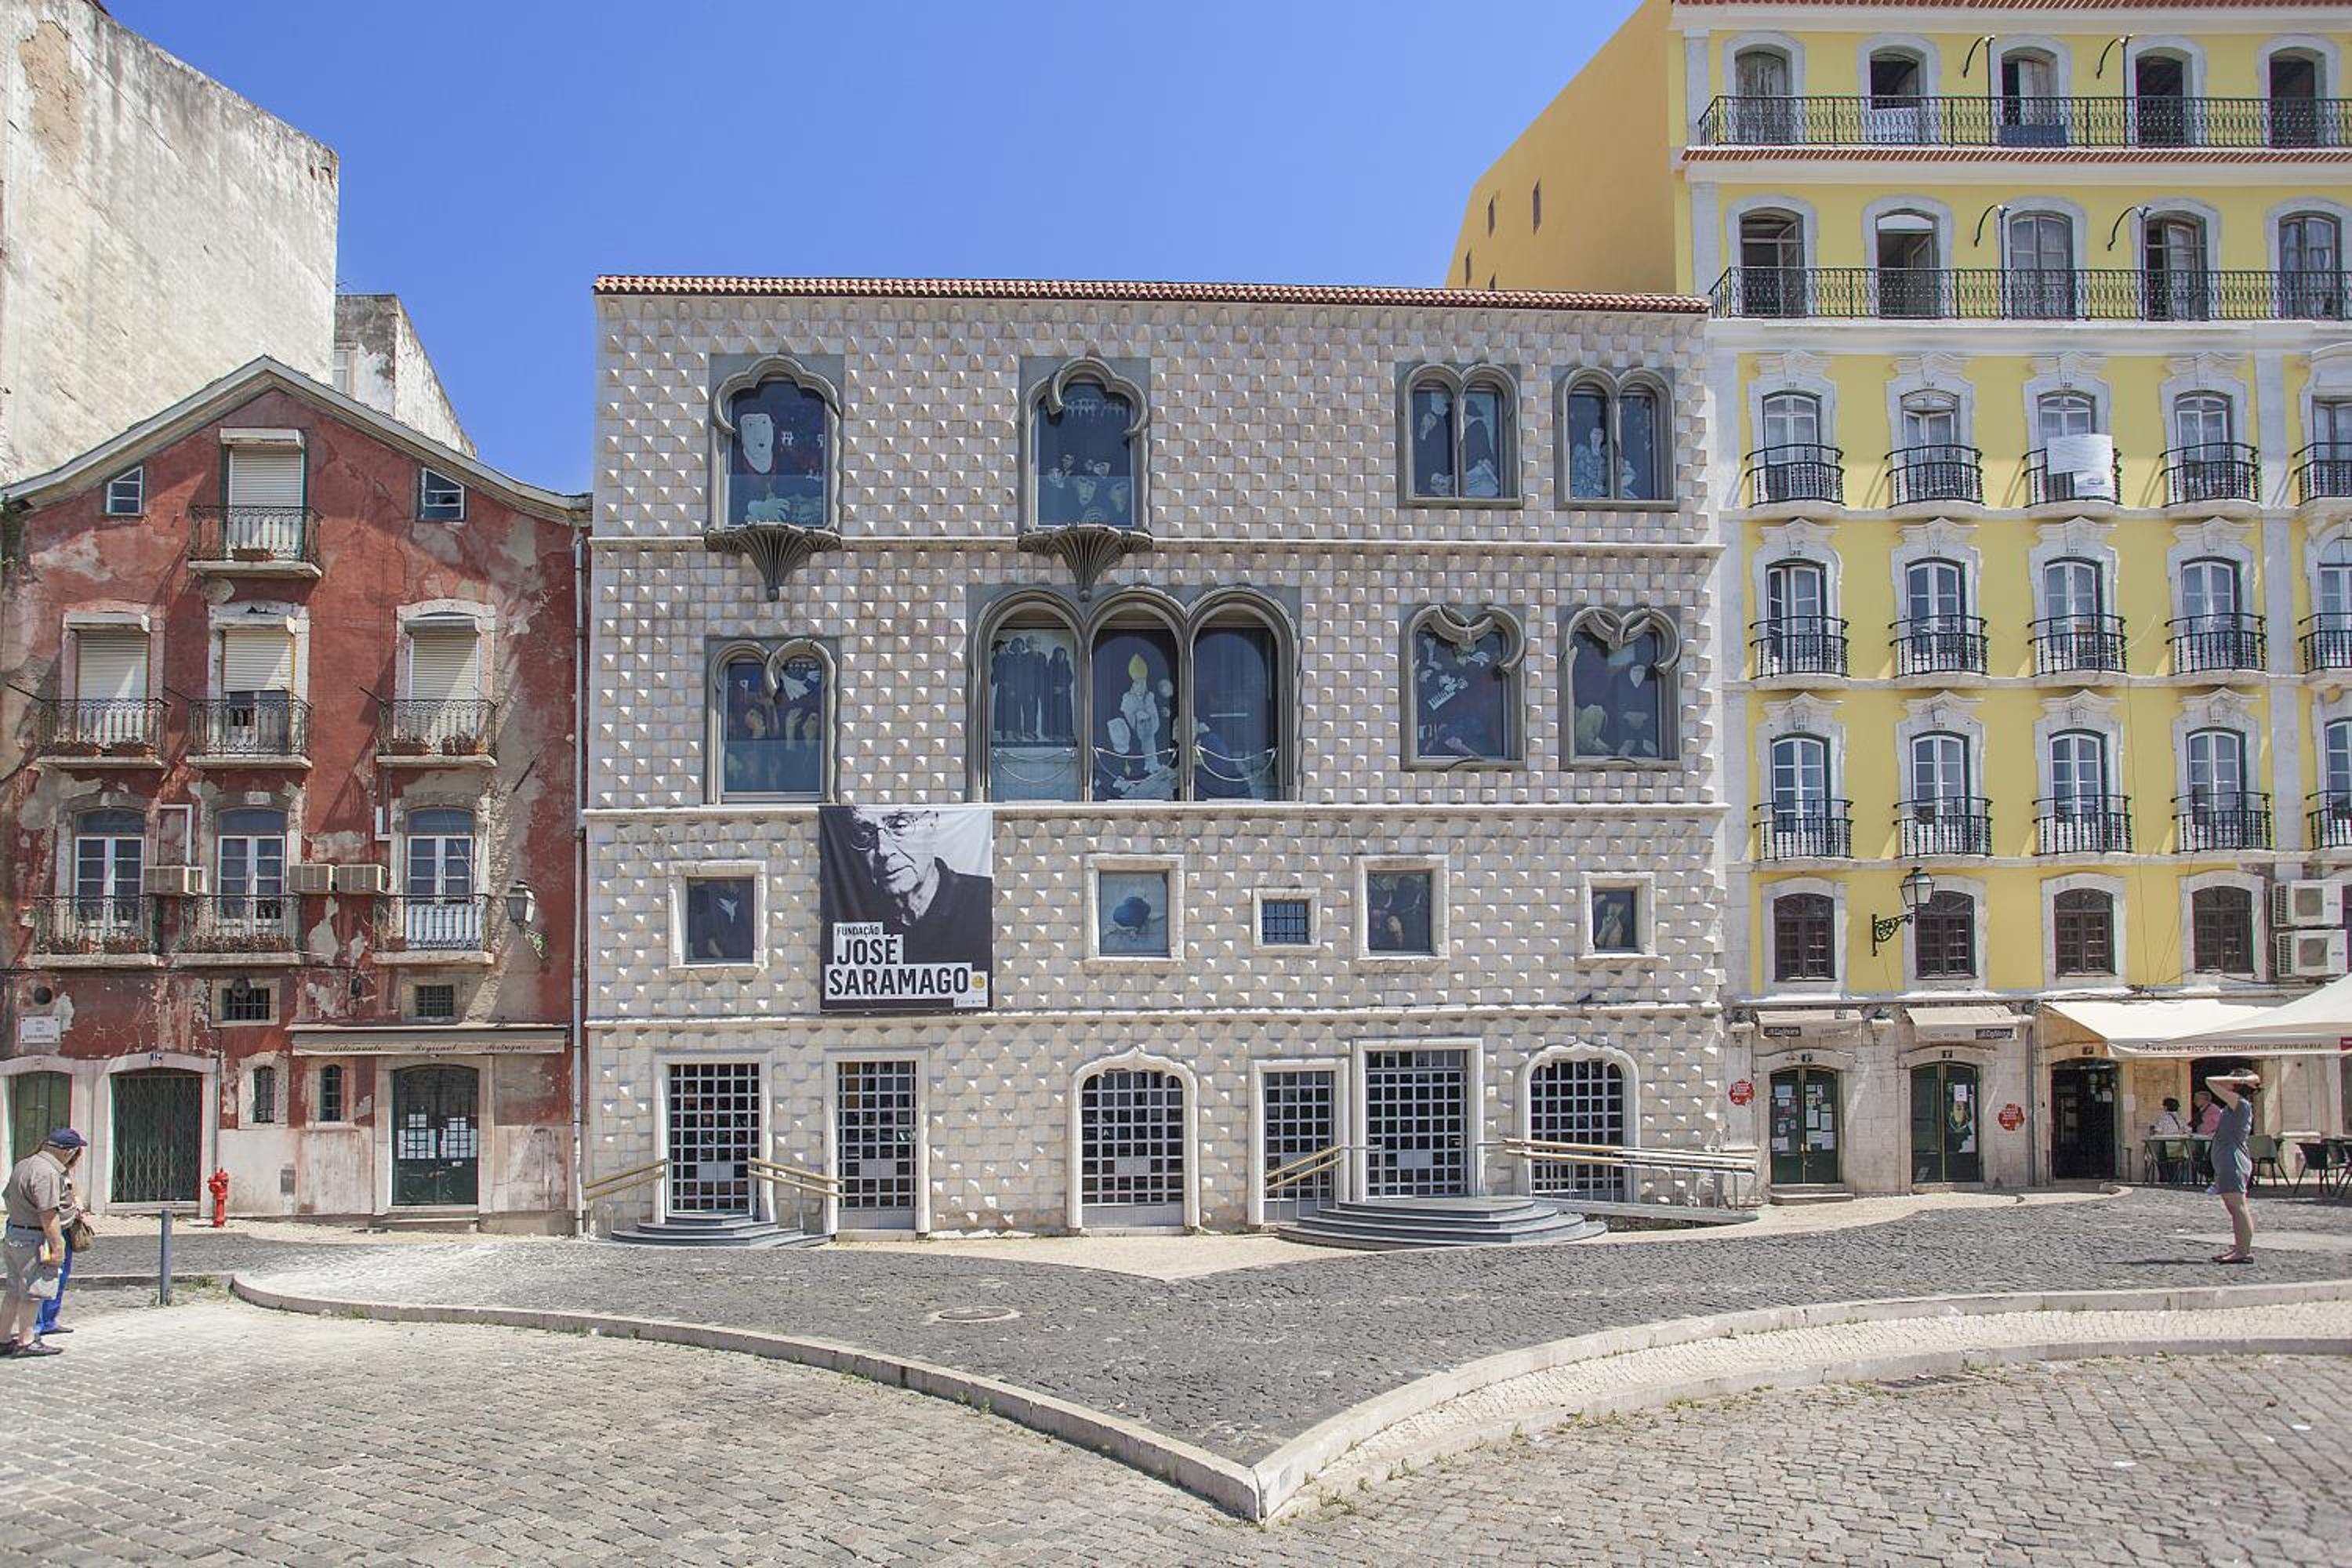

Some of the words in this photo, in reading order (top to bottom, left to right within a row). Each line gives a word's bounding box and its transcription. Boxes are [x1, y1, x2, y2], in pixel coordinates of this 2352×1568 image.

[837, 924, 880, 938] FUNDAÇÃO
[837, 934, 898, 965] JOSÉ
[829, 967, 968, 996] SARAMAGO
